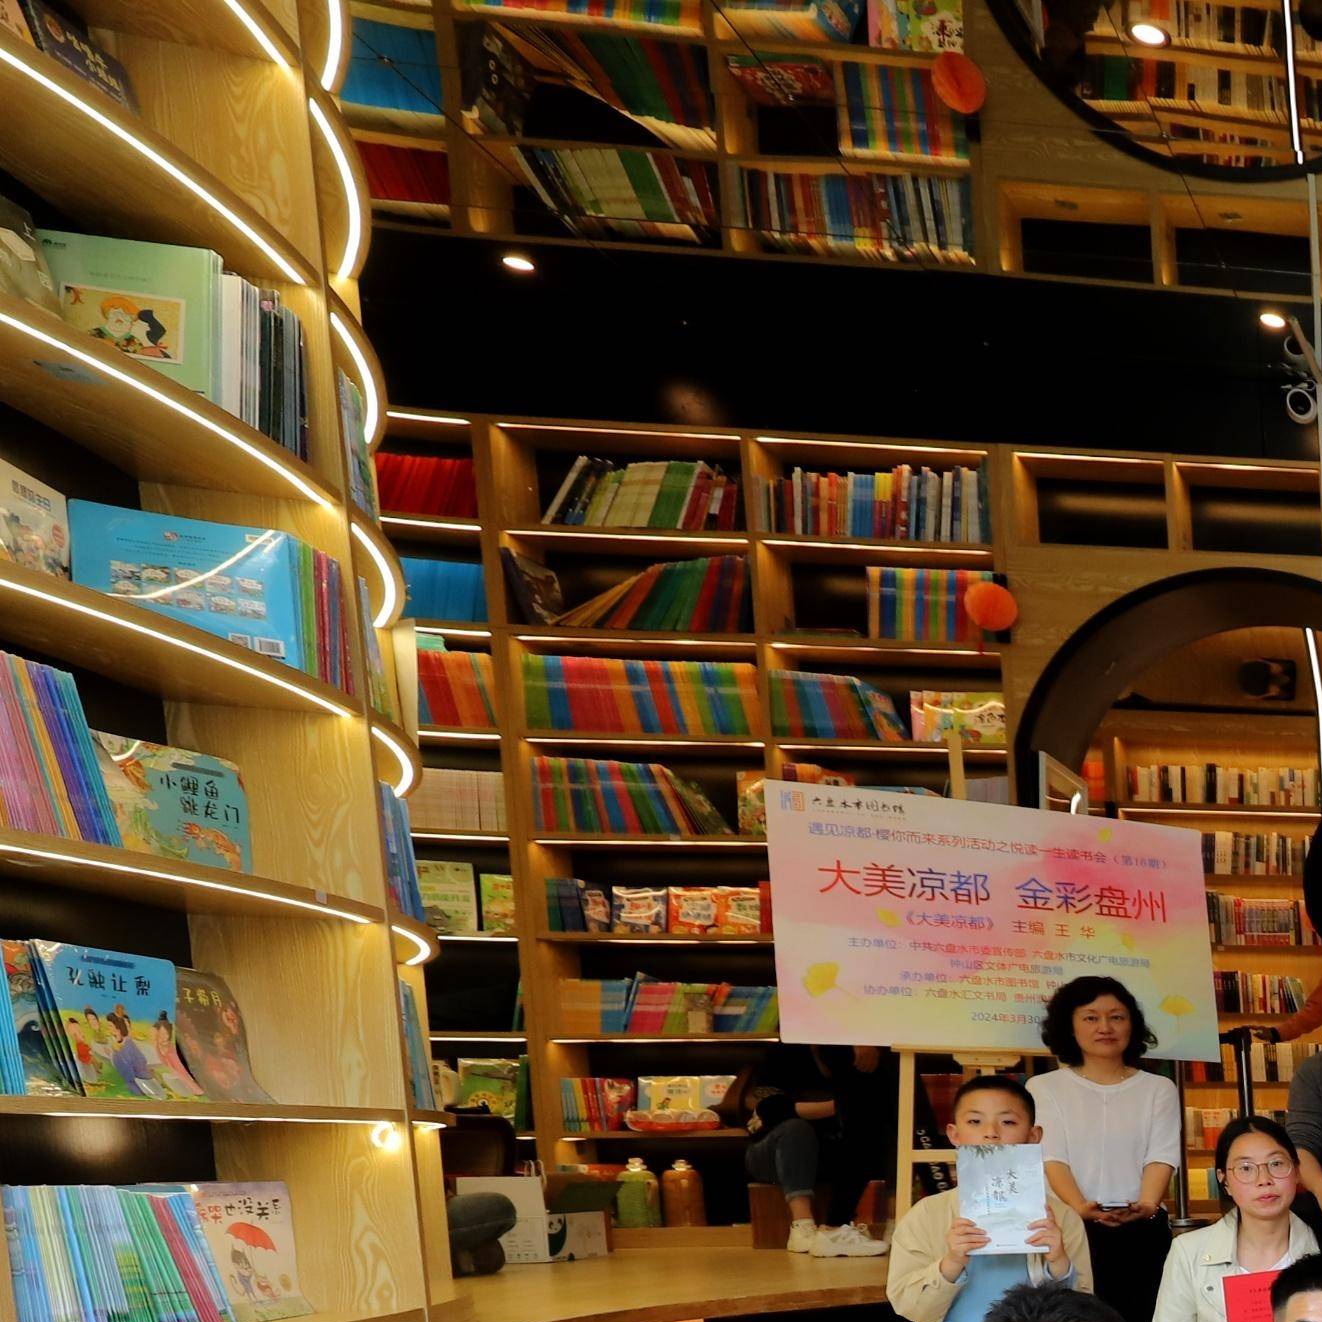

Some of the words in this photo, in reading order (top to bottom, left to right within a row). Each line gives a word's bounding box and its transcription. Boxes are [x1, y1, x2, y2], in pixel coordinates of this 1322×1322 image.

[160, 774, 220, 801] 小鲤鱼
[180, 797, 240, 824] 跳龙门
[818, 859, 990, 906] 大美凉都
[1015, 877, 1167, 923] 金彩盘州
[1012, 919, 1045, 936] 主编
[1055, 923, 1070, 938] 王
[1080, 926, 1096, 940] 华
[1006, 1169, 1019, 1195] 大美
